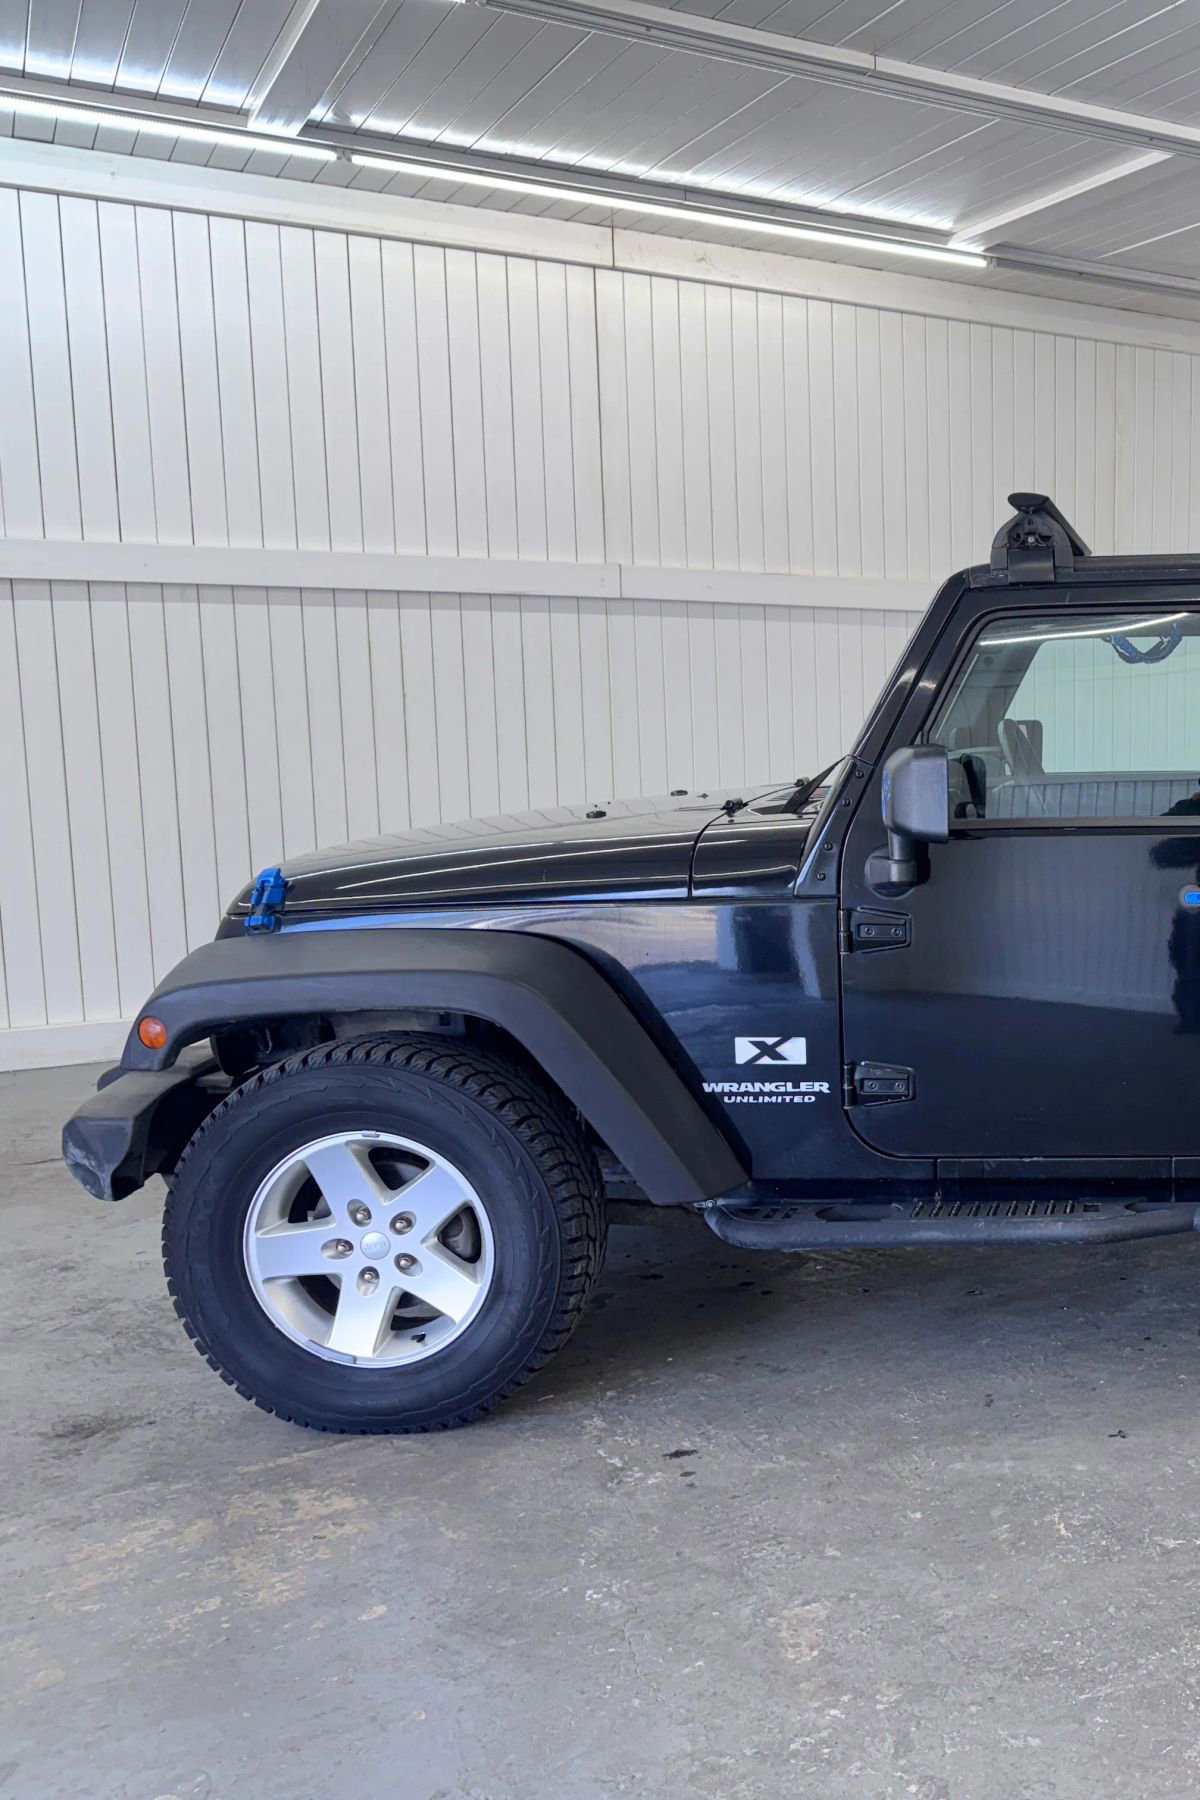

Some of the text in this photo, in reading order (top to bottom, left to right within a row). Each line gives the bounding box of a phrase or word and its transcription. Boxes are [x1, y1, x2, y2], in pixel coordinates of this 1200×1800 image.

[743, 1037, 794, 1065] X
[702, 1081, 831, 1094] WRANGLER
[723, 1095, 816, 1104] UNLIMITED
